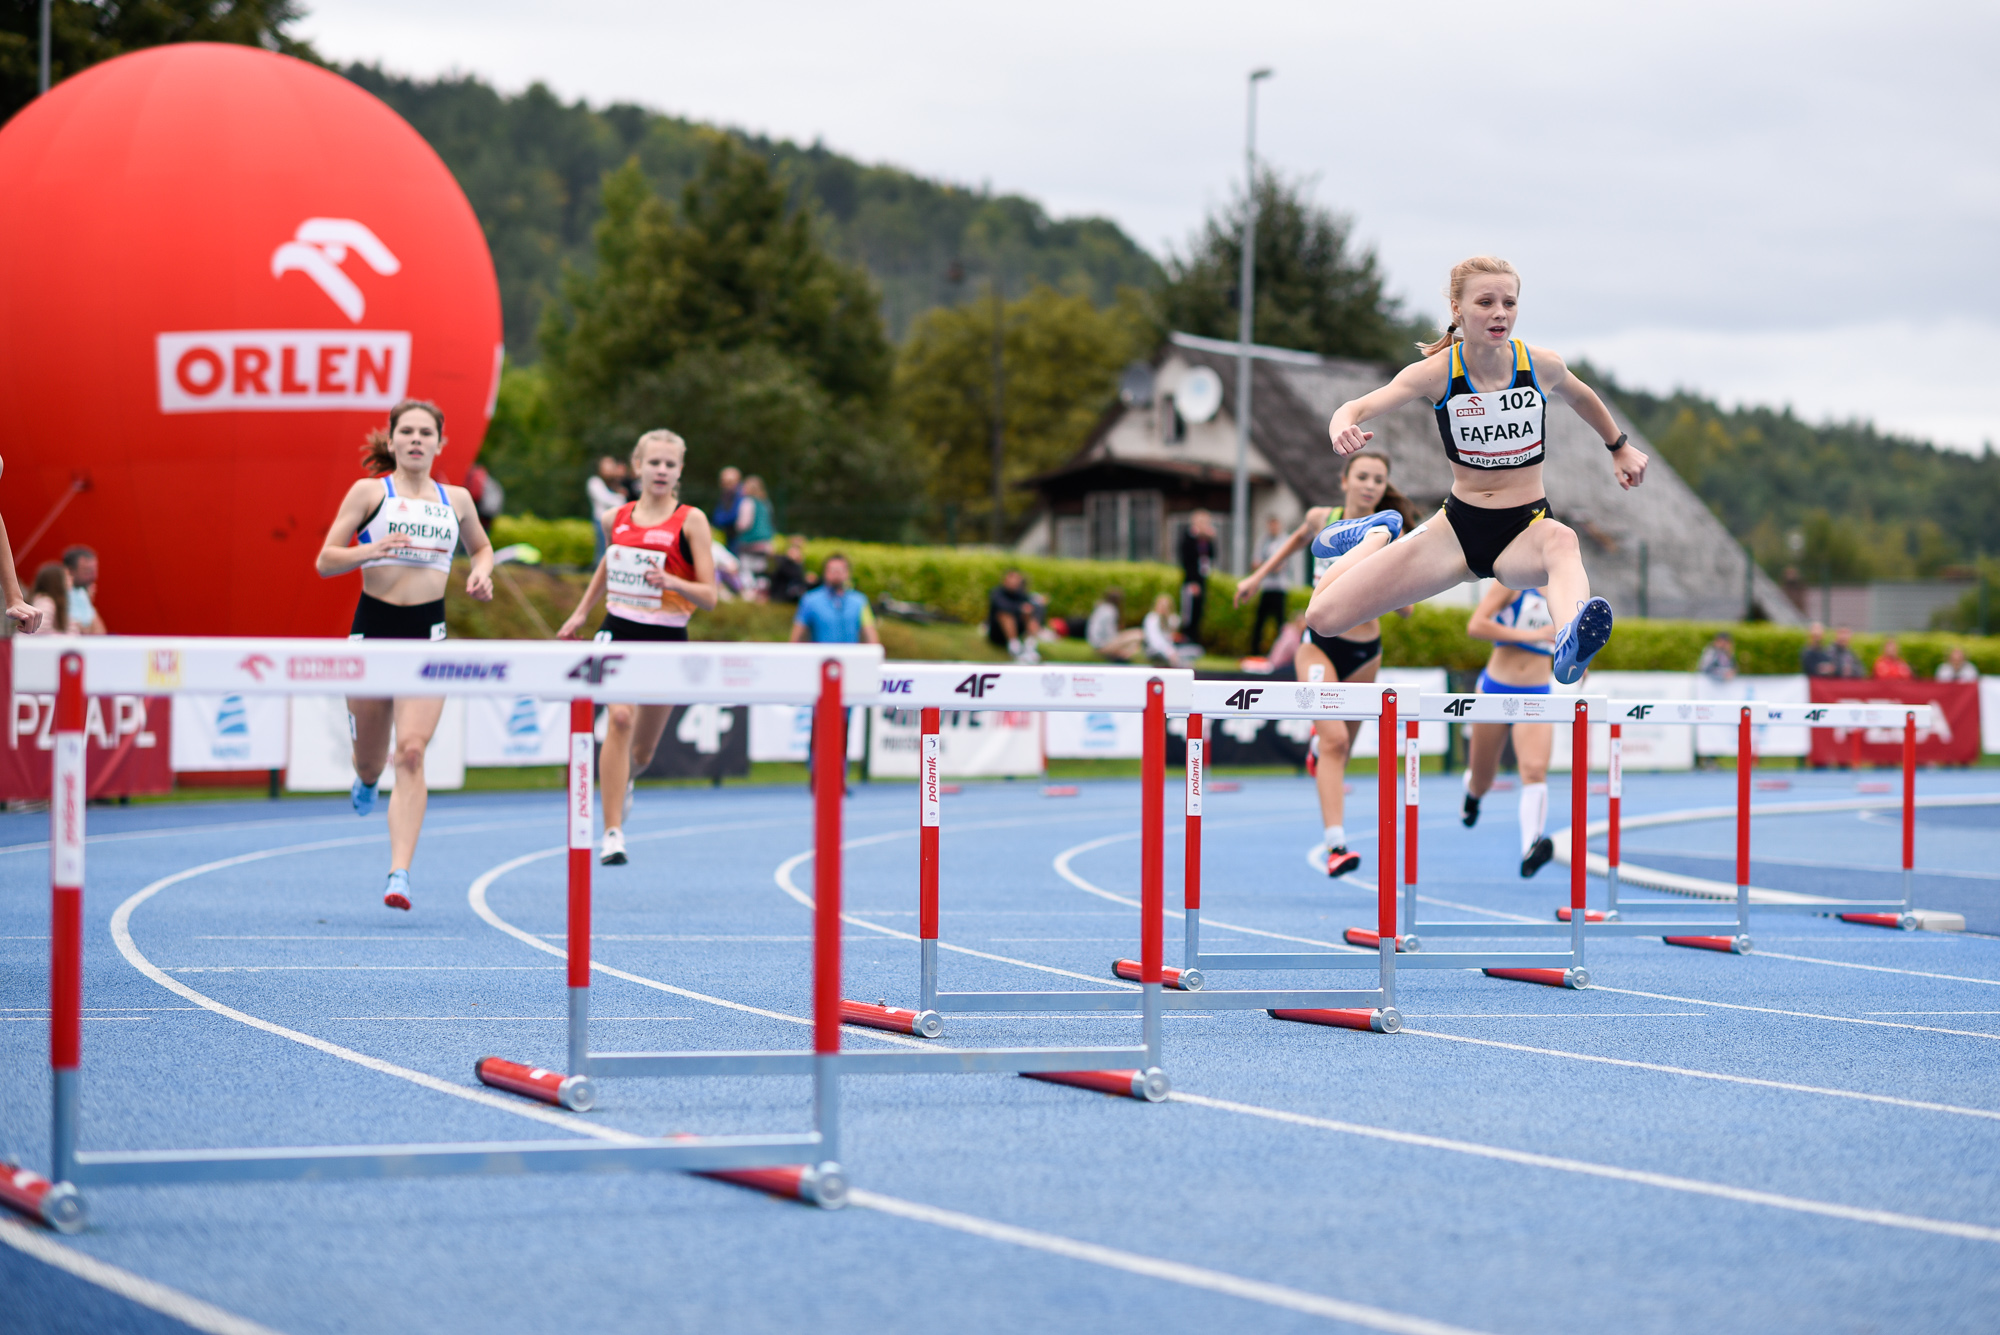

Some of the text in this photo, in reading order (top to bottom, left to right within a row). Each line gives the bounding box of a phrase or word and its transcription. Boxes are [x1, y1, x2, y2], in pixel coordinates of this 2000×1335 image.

[175, 345, 394, 397] ORLEN
[1457, 408, 1484, 416] ORLEN
[1499, 390, 1536, 412] 102
[1460, 420, 1534, 445] FĄFARA
[1469, 456, 1511, 466] KARPACZ
[1514, 452, 1531, 464] 2021
[424, 504, 449, 518] 832
[388, 522, 452, 540] ROSIEJKA
[567, 654, 626, 683] 4F
[955, 673, 1001, 697] 4F
[1225, 688, 1264, 710] 4F
[1443, 698, 1476, 716] 4F
[10, 694, 156, 749] PZA.PL
[1626, 705, 1654, 720] 4F
[1804, 708, 1828, 721] 4F
[926, 755, 938, 803] polanik
[1191, 757, 1201, 796] polanik
[577, 762, 589, 818] polanik
